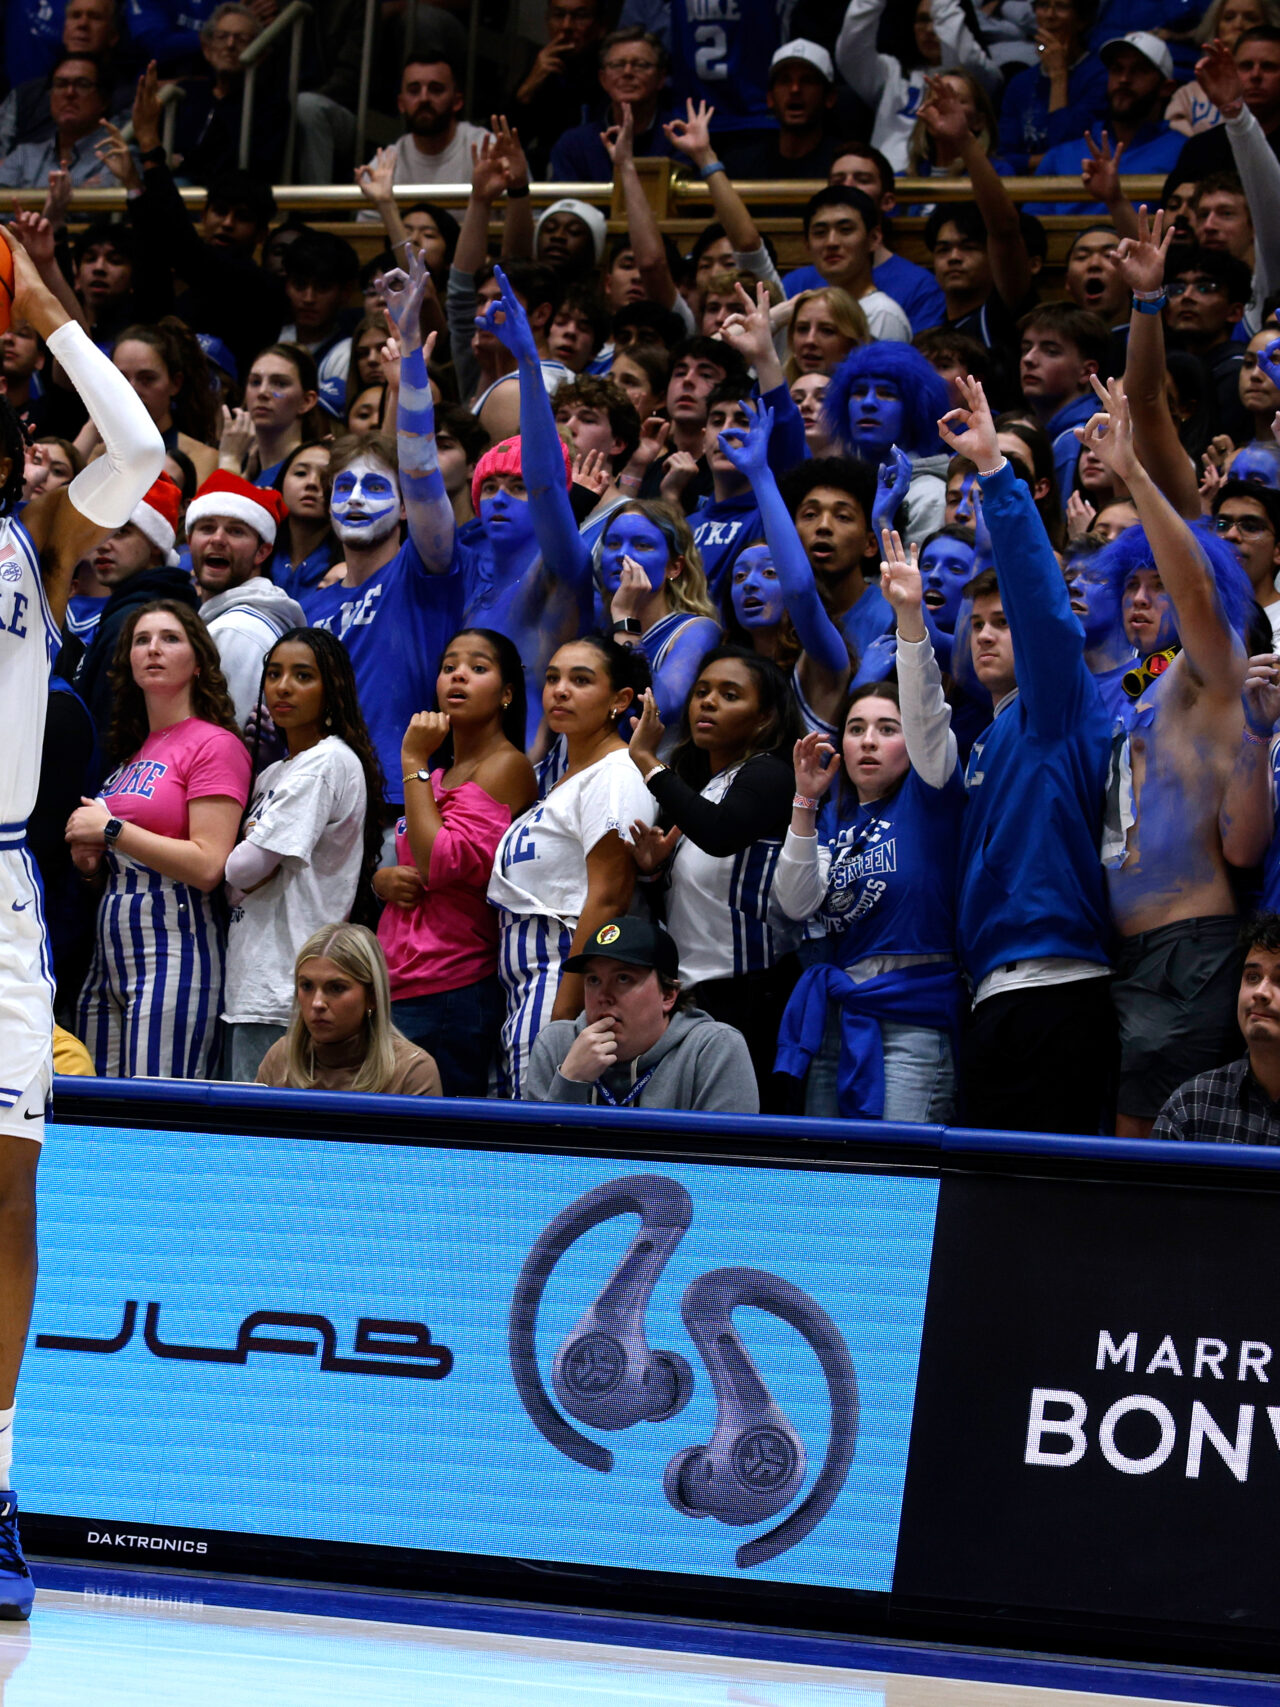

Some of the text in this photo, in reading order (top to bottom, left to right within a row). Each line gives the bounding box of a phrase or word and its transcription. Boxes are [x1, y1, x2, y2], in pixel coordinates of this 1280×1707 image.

[694, 25, 728, 80] 2
[35, 1300, 454, 1380] JLAB
[1024, 1386, 1280, 1483] BON
[87, 1531, 208, 1554] DAKTRONICS
